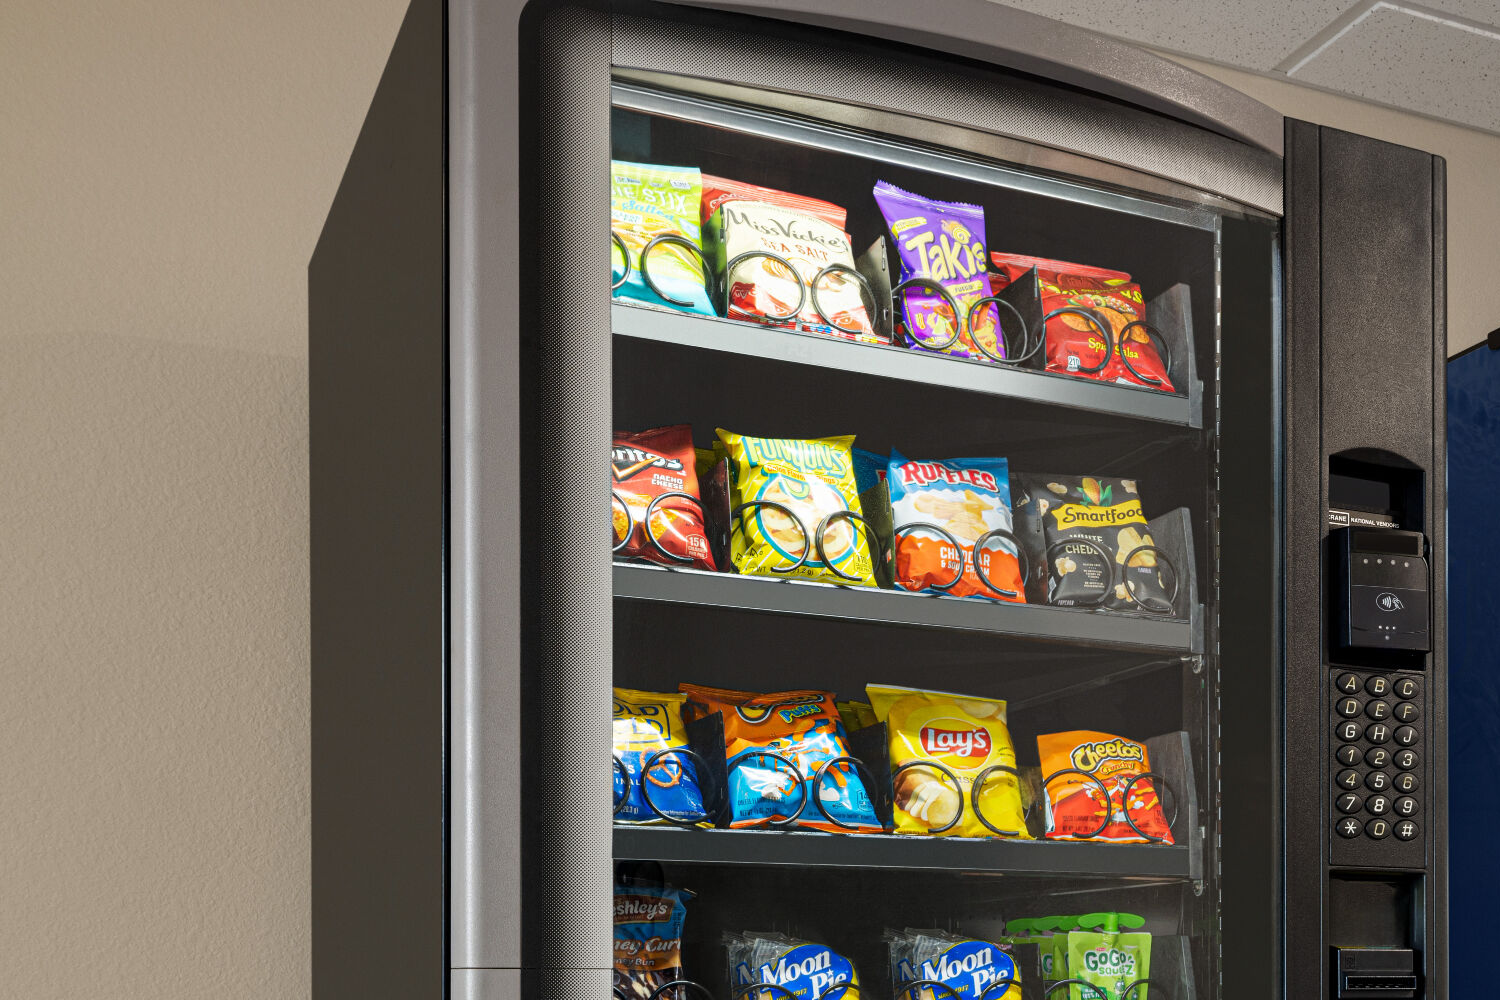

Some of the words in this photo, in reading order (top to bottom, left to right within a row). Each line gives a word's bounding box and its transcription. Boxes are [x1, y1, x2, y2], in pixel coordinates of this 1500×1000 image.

[642, 188, 687, 216] STIX
[726, 208, 779, 236] Miss
[768, 218, 849, 253] Vickie's
[761, 237, 791, 253] SEA
[795, 244, 828, 261] SALT
[905, 231, 987, 281] Takis
[1088, 337, 1107, 353] Spic
[612, 448, 684, 471] ritos
[742, 436, 847, 479] FUNYUNS
[651, 479, 684, 490] CHEESE
[653, 473, 683, 484] NACHO
[901, 462, 998, 492] RUFFLES
[1350, 517, 1376, 526] NATIONAL
[1376, 520, 1400, 529] VENDORS
[1065, 545, 1099, 555] CHED
[948, 561, 962, 572] SOU
[966, 565, 990, 577] CRAM
[1345, 676, 1356, 690] A
[1374, 679, 1385, 692] B
[1403, 682, 1413, 695] C
[612, 702, 660, 717] OLD
[779, 704, 820, 723] Puffs
[1345, 701, 1357, 714] D
[1375, 704, 1385, 717] E
[1403, 706, 1412, 719] F
[927, 727, 986, 758] Lay's
[1345, 725, 1356, 738] G
[1373, 727, 1385, 740] H
[1403, 729, 1412, 742] J
[1074, 739, 1142, 772] Cheetos
[1348, 749, 1354, 762] 1
[1374, 752, 1385, 765] 2
[1403, 753, 1413, 766] 3
[1100, 760, 1135, 775] Crunchy
[1345, 774, 1356, 786] 4
[1375, 775, 1384, 788] 5
[1403, 776, 1413, 789] 6
[1345, 797, 1355, 810] 7
[1374, 799, 1385, 812] 8
[1403, 800, 1413, 813] 9
[1374, 822, 1385, 835] 0
[922, 947, 993, 988] Moon
[1085, 949, 1127, 971] GoGo
[761, 950, 832, 992] Moon
[809, 968, 847, 1000] Pie
[971, 965, 1009, 997] Pie
